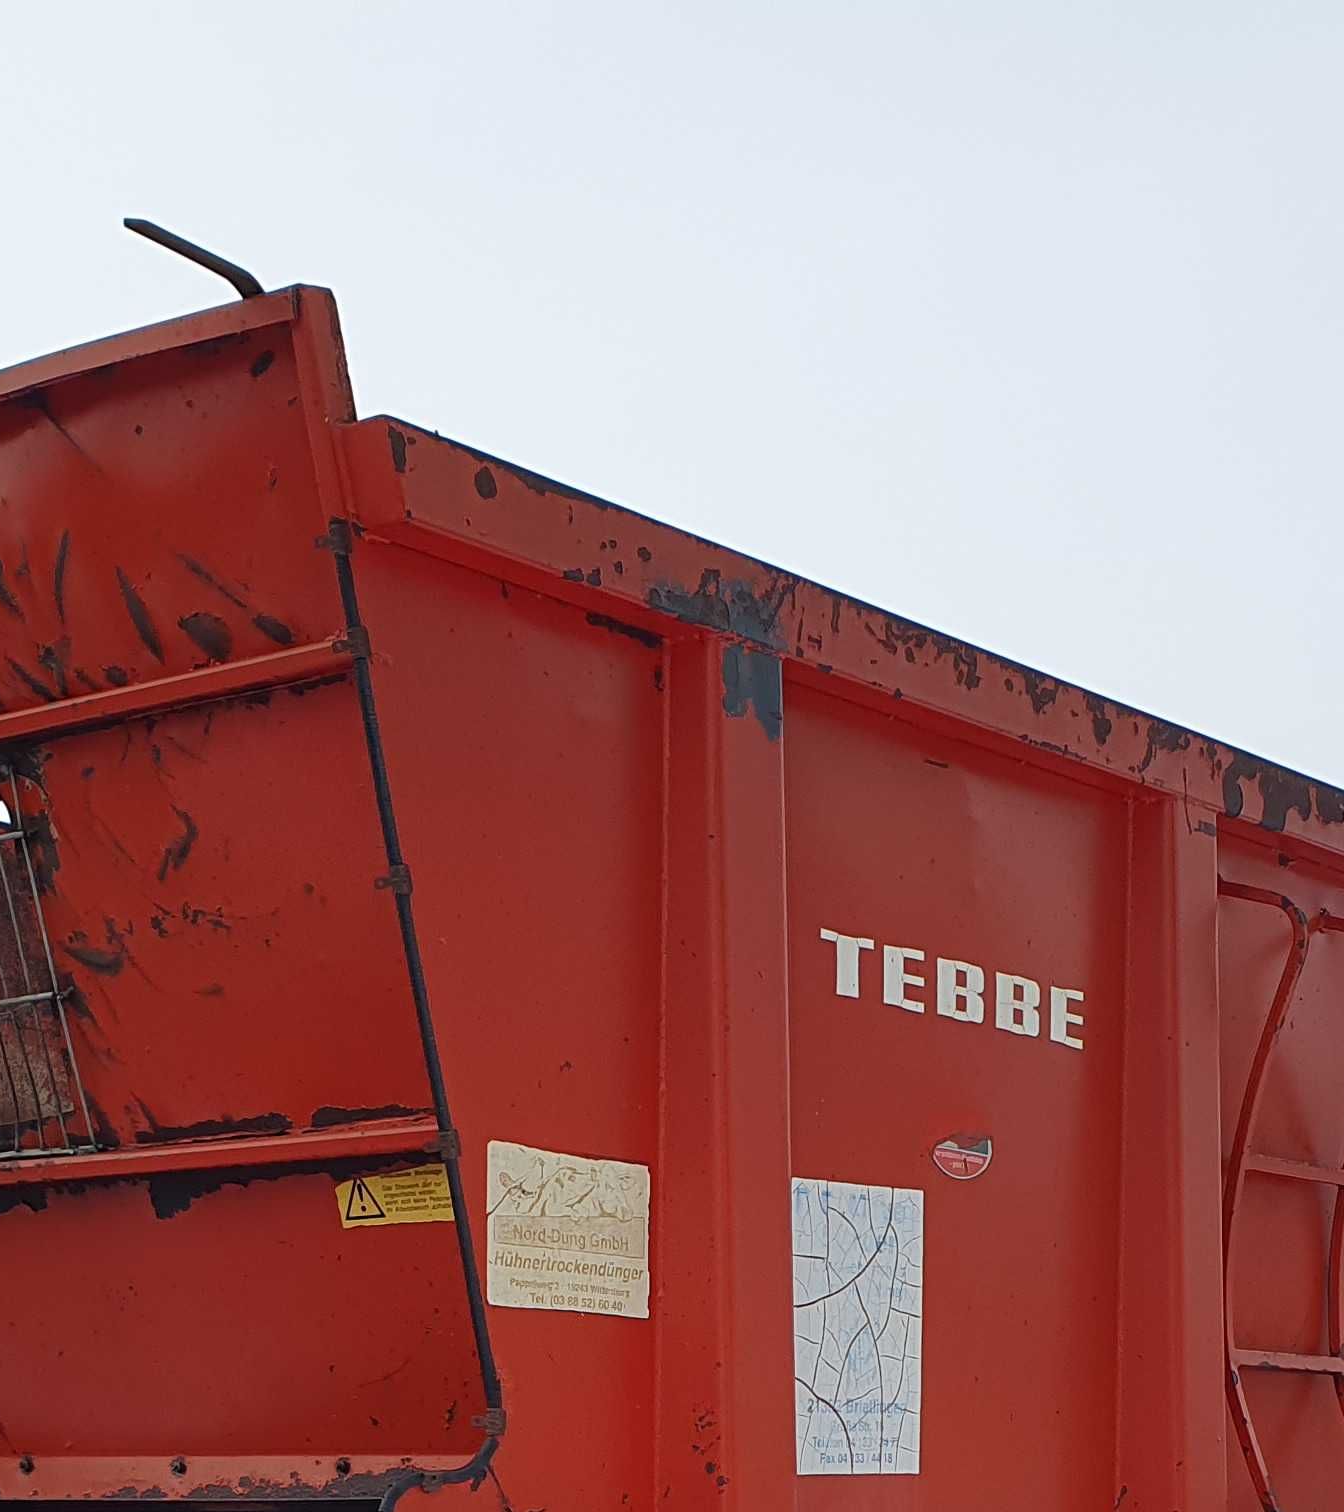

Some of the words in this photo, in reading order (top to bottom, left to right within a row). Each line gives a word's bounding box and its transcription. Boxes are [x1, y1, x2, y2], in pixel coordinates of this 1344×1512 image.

[820, 928, 1085, 1050] TEBBE
[512, 1224, 587, 1249] Nord-Dung
[590, 1233, 630, 1252] GmbH
[494, 1249, 644, 1283] Hühnertrockendünger
[550, 1294, 566, 1307] (03
[567, 1296, 579, 1307] 88
[581, 1298, 596, 1309] 52)
[837, 1452, 865, 1465] 0433
